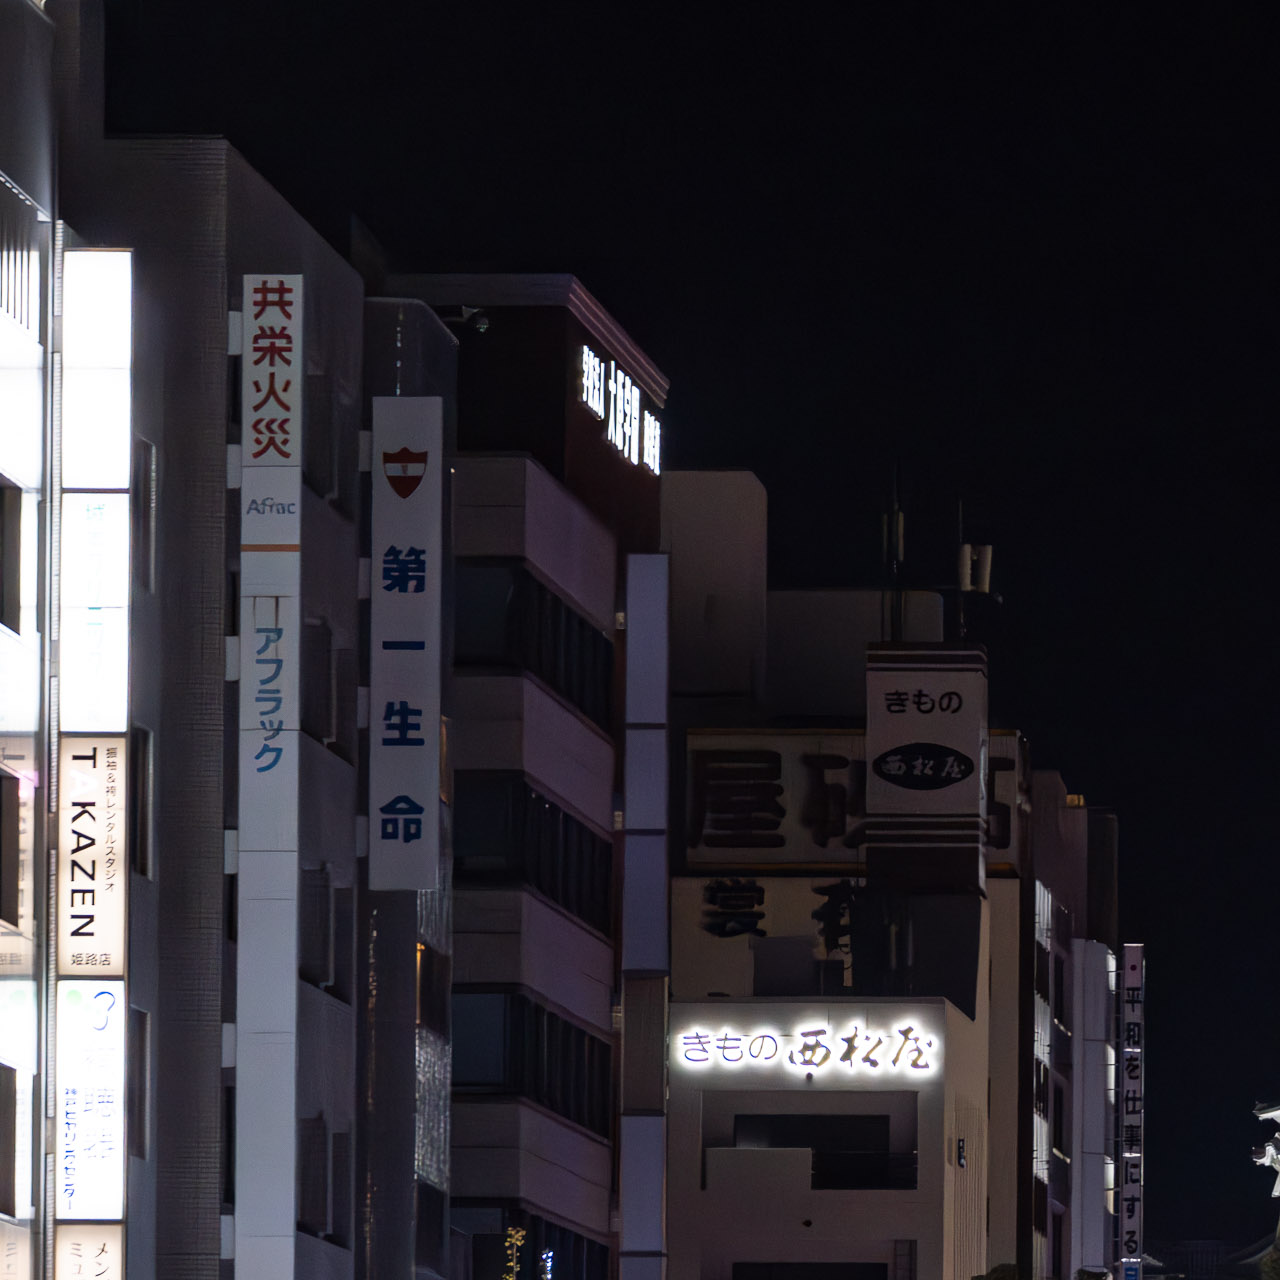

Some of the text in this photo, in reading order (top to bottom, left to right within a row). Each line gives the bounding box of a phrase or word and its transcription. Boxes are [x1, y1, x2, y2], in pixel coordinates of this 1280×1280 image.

[252, 280, 294, 460] 共栄火災
[246, 497, 297, 516] Aflac
[254, 627, 284, 773] アフラック
[379, 545, 427, 844] 第一生命
[883, 688, 963, 714] きもの
[880, 754, 967, 778] 西松屋
[70, 746, 98, 937] TAKAZEN
[70, 952, 112, 967] 姫路店
[683, 1025, 933, 1069] きもの 西松屋
[1123, 986, 1142, 1256] 平和を仕事にする
